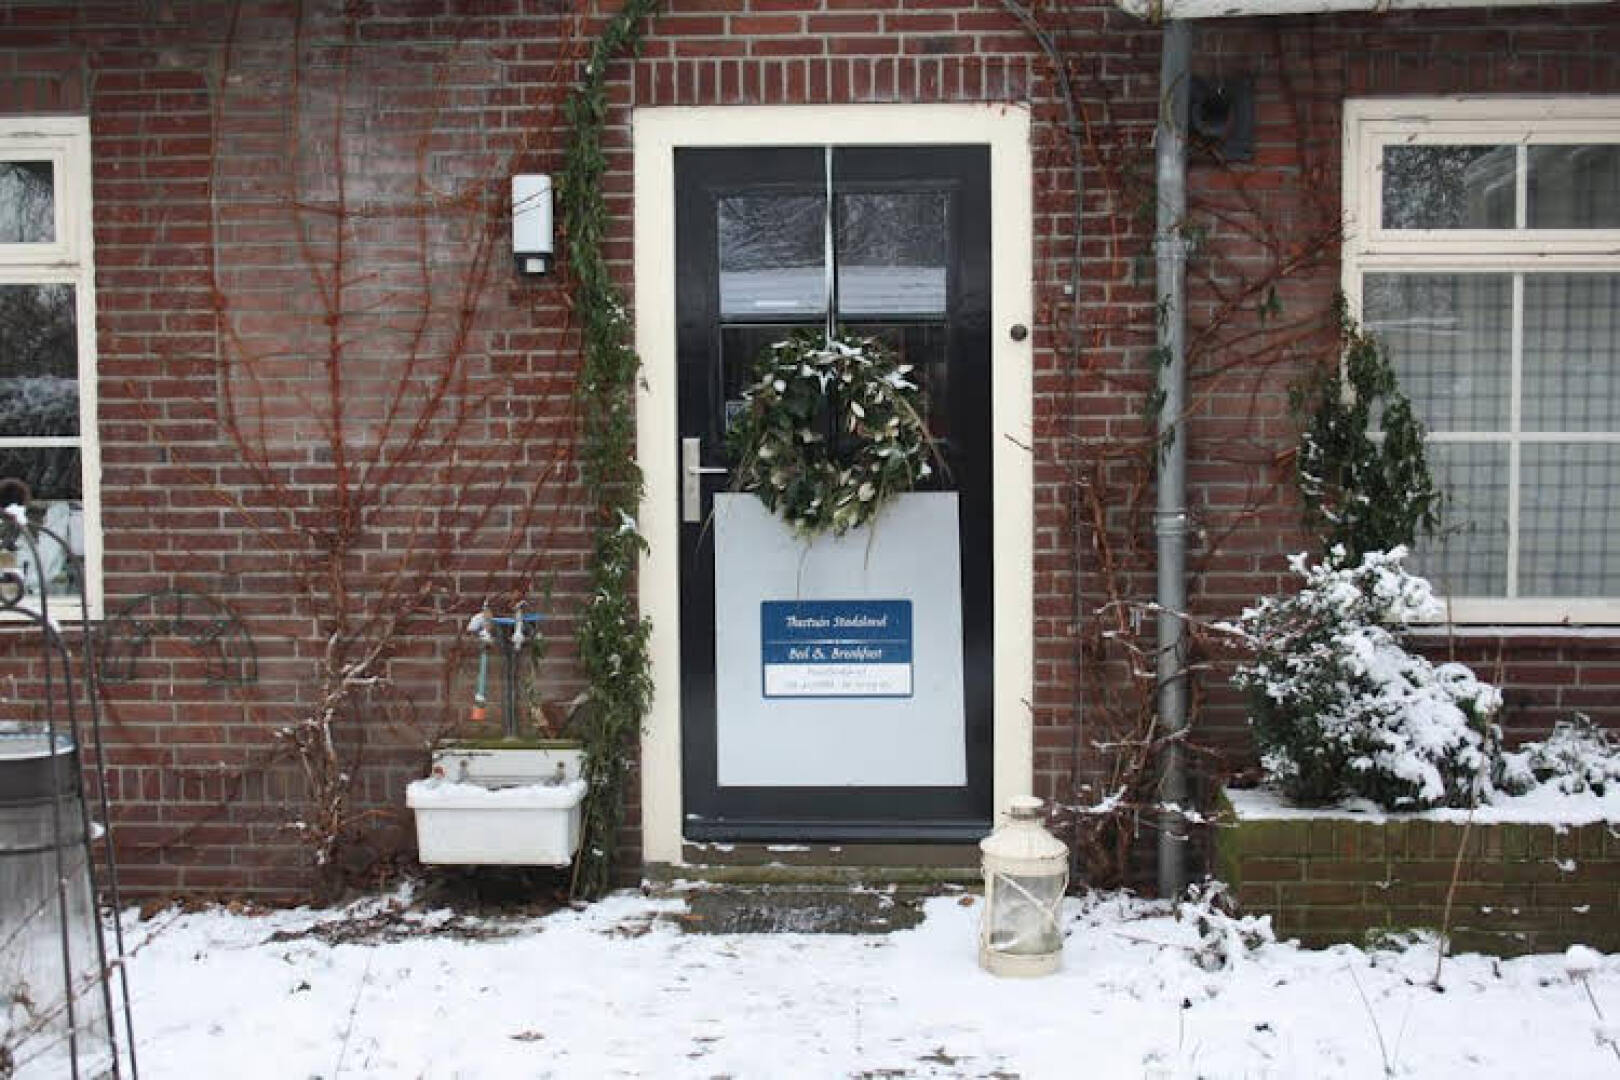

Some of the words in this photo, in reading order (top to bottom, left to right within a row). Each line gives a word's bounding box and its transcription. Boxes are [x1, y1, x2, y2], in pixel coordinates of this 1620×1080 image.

[788, 647, 810, 661] Bed
[812, 647, 826, 660] &
[831, 646, 882, 662] Breakfast
